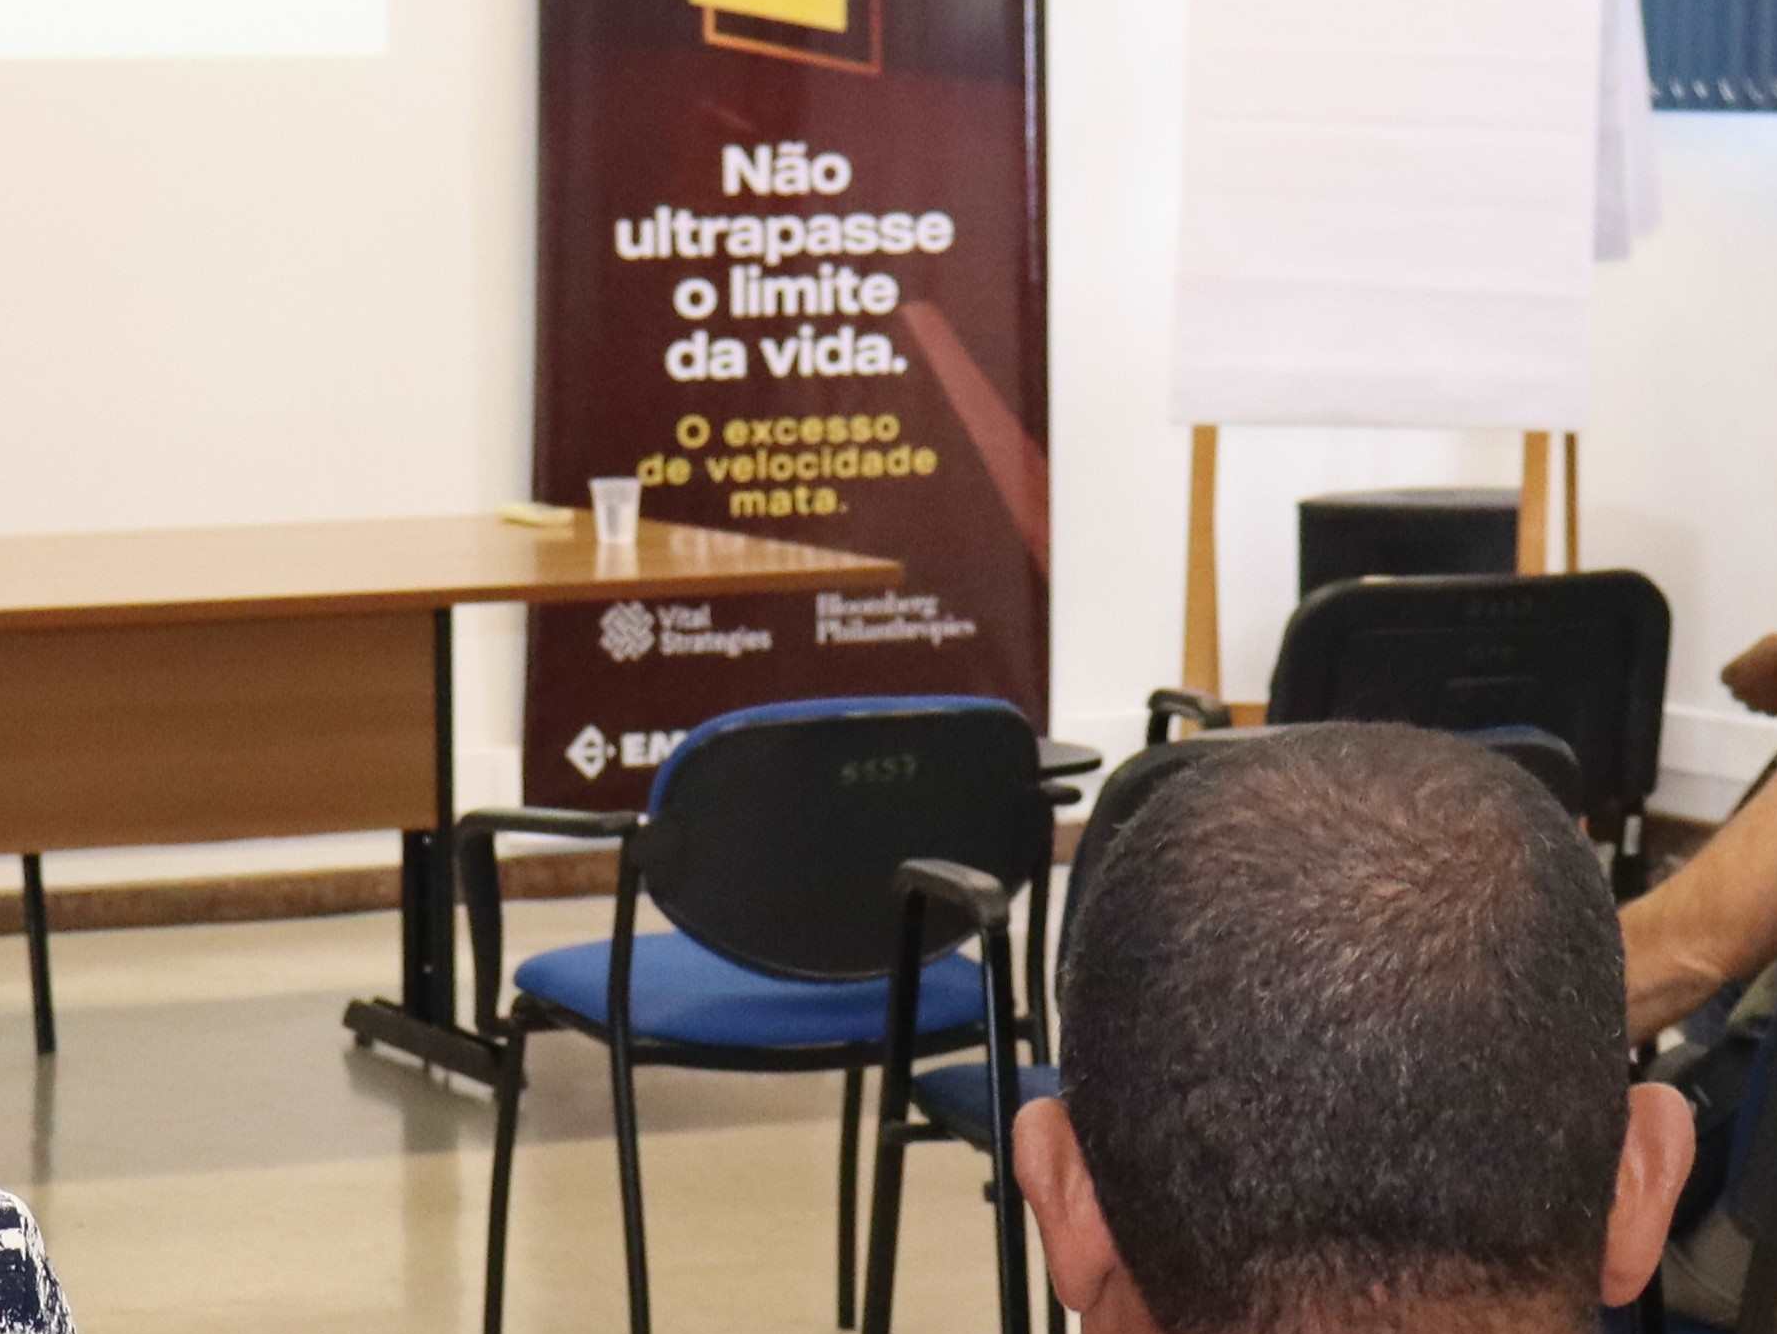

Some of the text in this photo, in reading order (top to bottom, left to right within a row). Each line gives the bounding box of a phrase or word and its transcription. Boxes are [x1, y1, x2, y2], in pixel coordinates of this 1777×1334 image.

[722, 143, 852, 197] Não
[614, 206, 954, 266] ultrapasse
[674, 264, 898, 320] o limite
[665, 323, 907, 382] da vida.
[676, 414, 900, 447] O excesso
[636, 445, 938, 486] de velocidade
[659, 605, 711, 628] Vital
